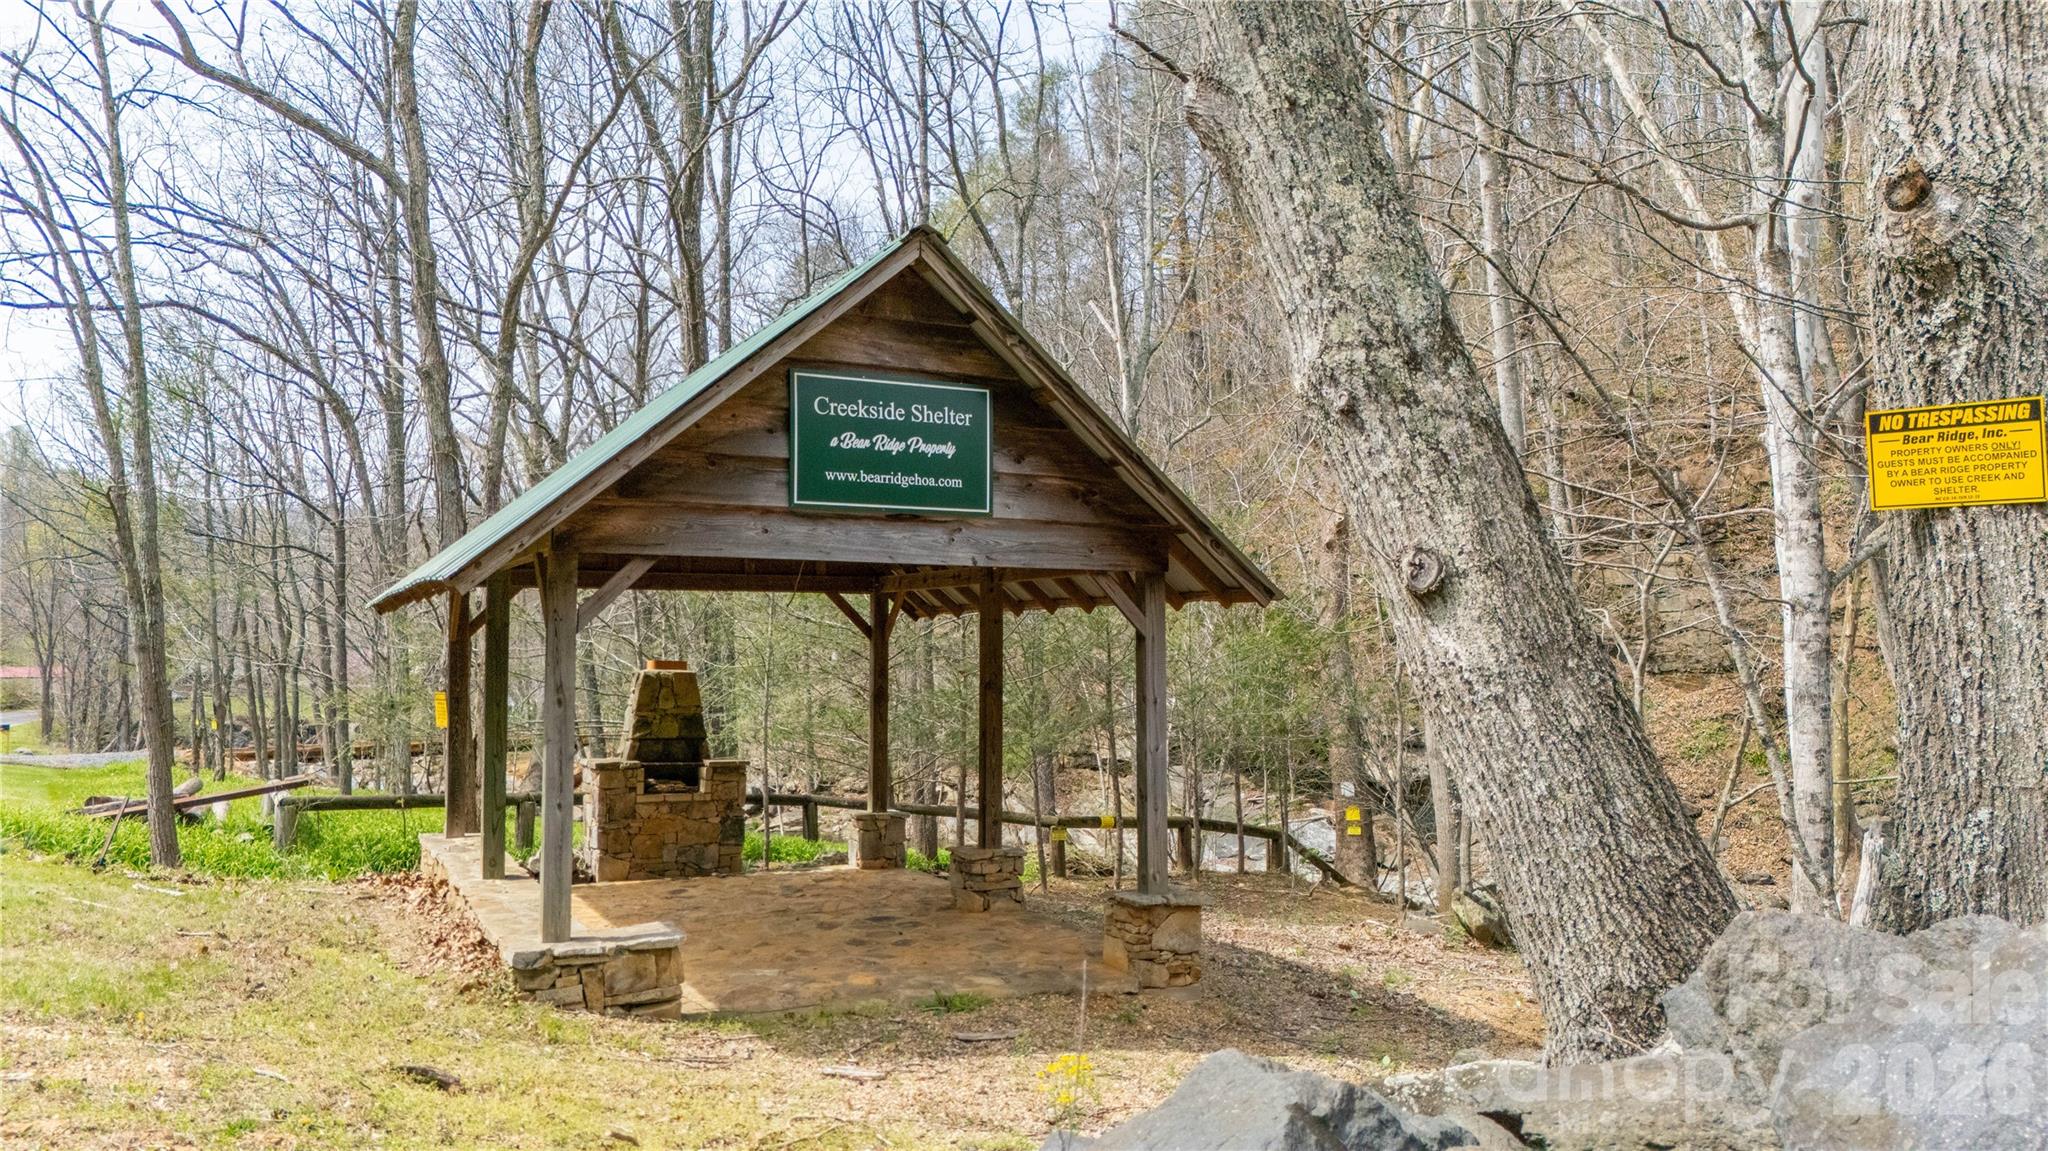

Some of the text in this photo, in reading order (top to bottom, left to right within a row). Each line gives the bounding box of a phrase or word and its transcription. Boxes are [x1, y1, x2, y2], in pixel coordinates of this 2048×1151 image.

[814, 396, 972, 426] Creekside Shelter
[1879, 402, 2031, 432] NO TRESPASSING
[829, 431, 957, 459] a Bear Ridge Property
[1902, 427, 2007, 445] Bear Ridge, Inc.
[1890, 440, 2021, 458] PROPERTY OWNERS ONLY!
[1877, 449, 2037, 469] GUESTS MUST BE ACCOMPANIED
[1887, 460, 2028, 478] BY A BEAR RIDGE PROPERTY
[825, 470, 962, 488] www.bearridgehoa.com
[1890, 471, 2025, 488] OWNER TO USE CREEK AND
